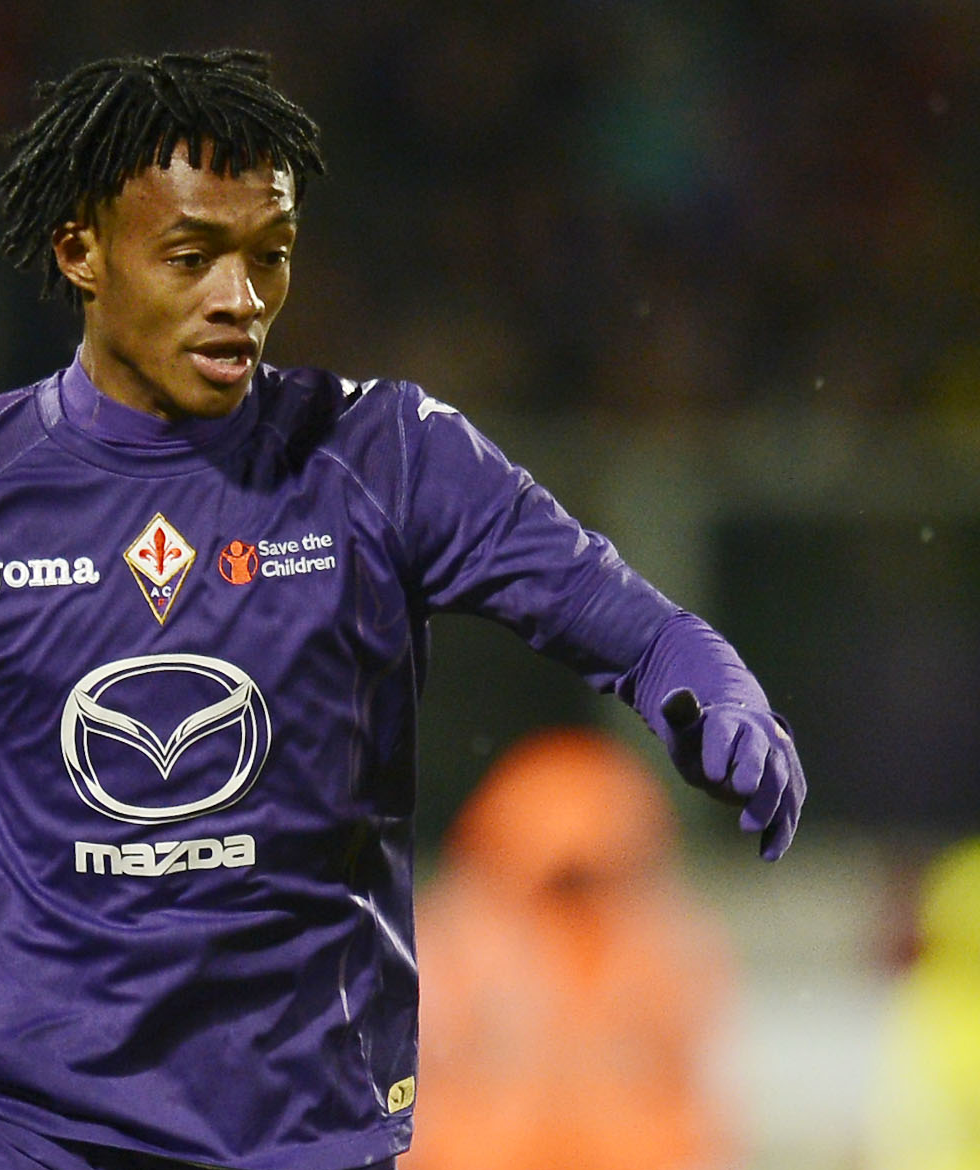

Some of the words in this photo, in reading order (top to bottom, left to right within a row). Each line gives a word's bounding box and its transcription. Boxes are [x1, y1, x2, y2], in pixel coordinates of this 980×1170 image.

[258, 540, 299, 556] Save
[302, 533, 333, 551] the
[261, 556, 335, 577] Children
